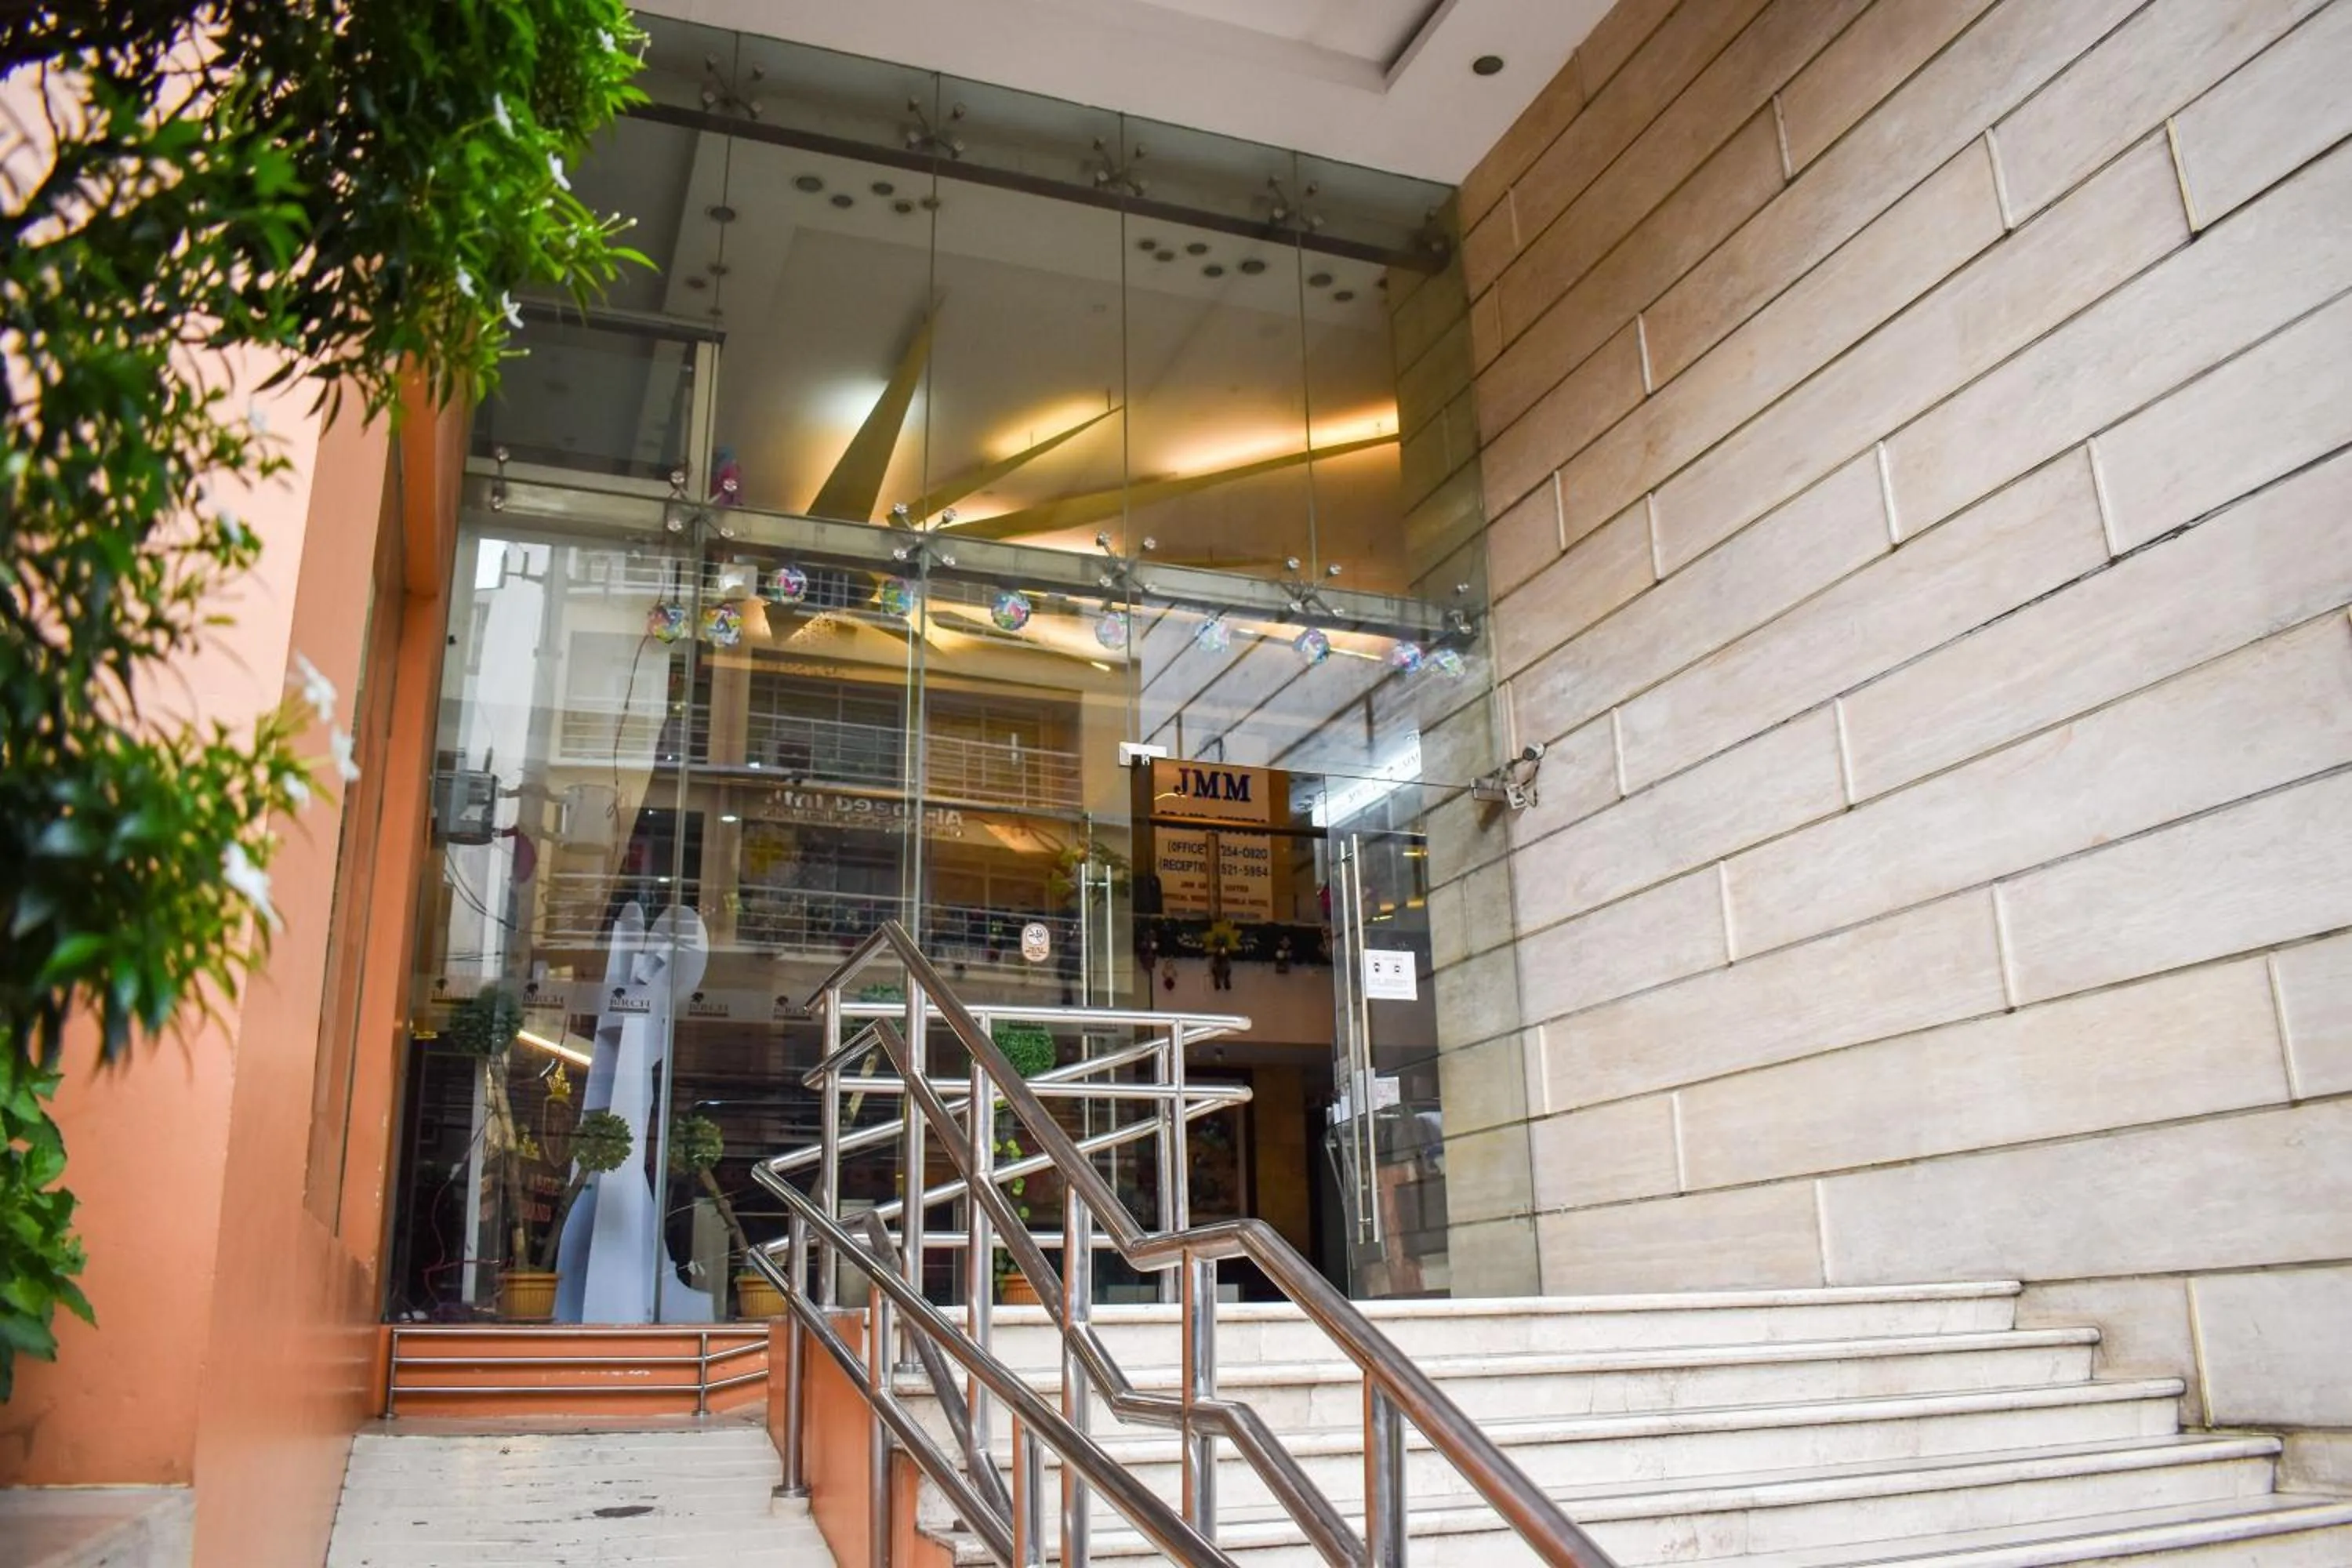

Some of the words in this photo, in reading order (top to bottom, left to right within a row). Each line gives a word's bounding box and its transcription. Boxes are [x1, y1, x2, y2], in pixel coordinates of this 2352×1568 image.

[1174, 768, 1251, 802] JMM
[1167, 840, 1208, 855] (OFFICE
[1160, 856, 1207, 873] (RECEPTIO
